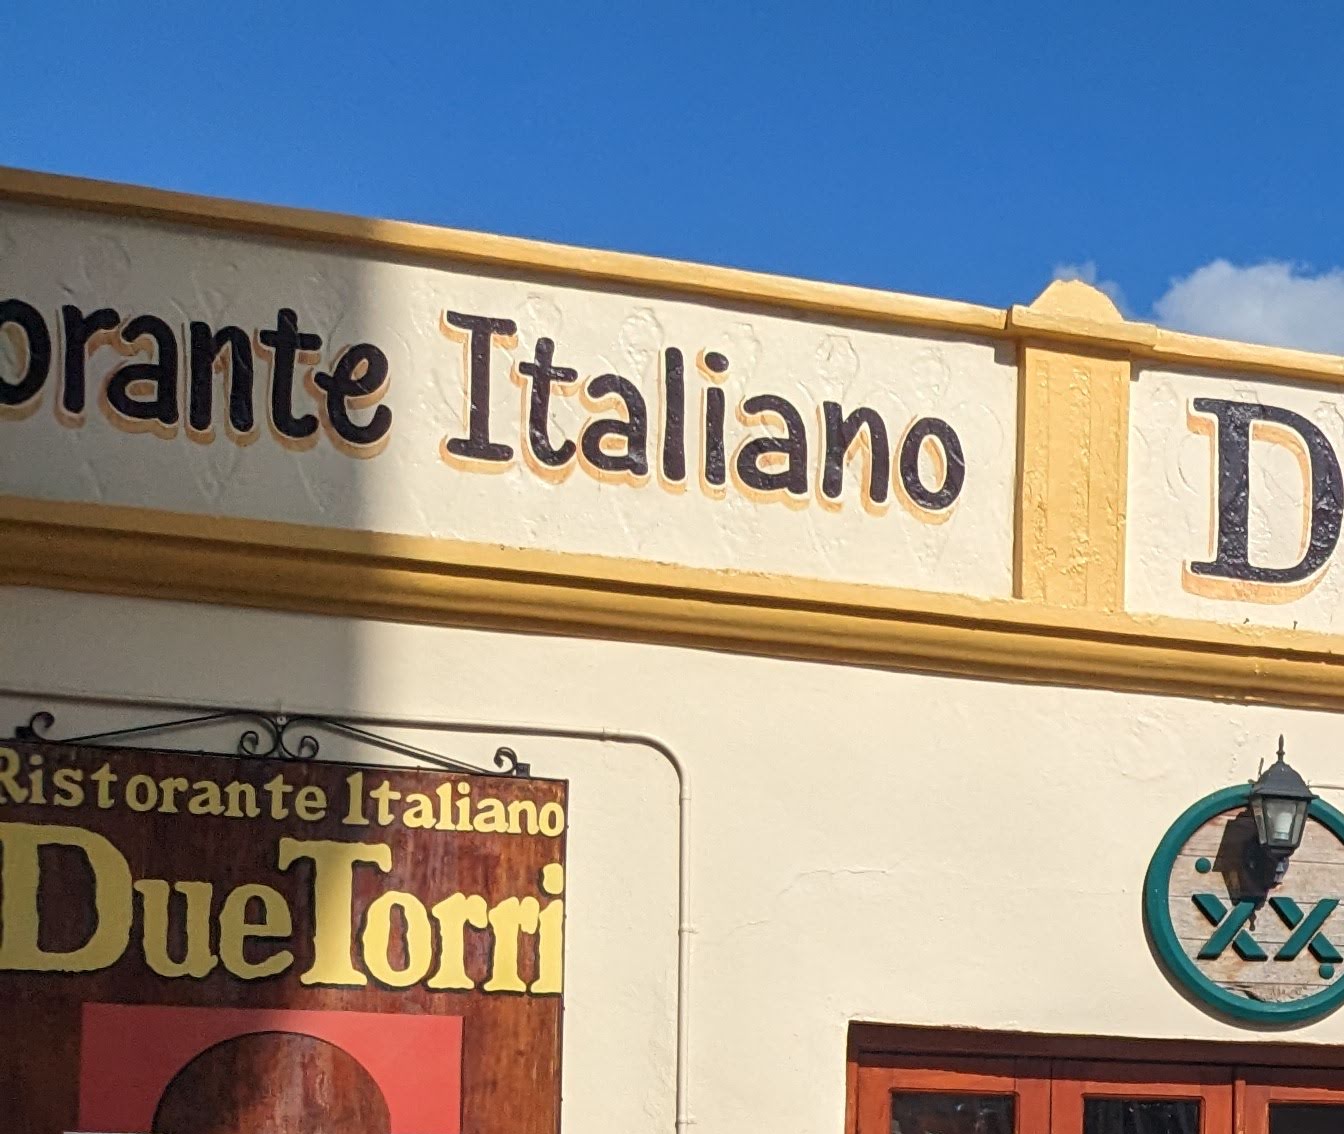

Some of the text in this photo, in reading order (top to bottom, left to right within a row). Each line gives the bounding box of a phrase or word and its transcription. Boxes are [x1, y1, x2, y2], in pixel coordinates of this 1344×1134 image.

[446, 310, 966, 511] Italiano
[0, 747, 565, 838] Ristorante Italiano
[0, 822, 564, 994] Due Torri
